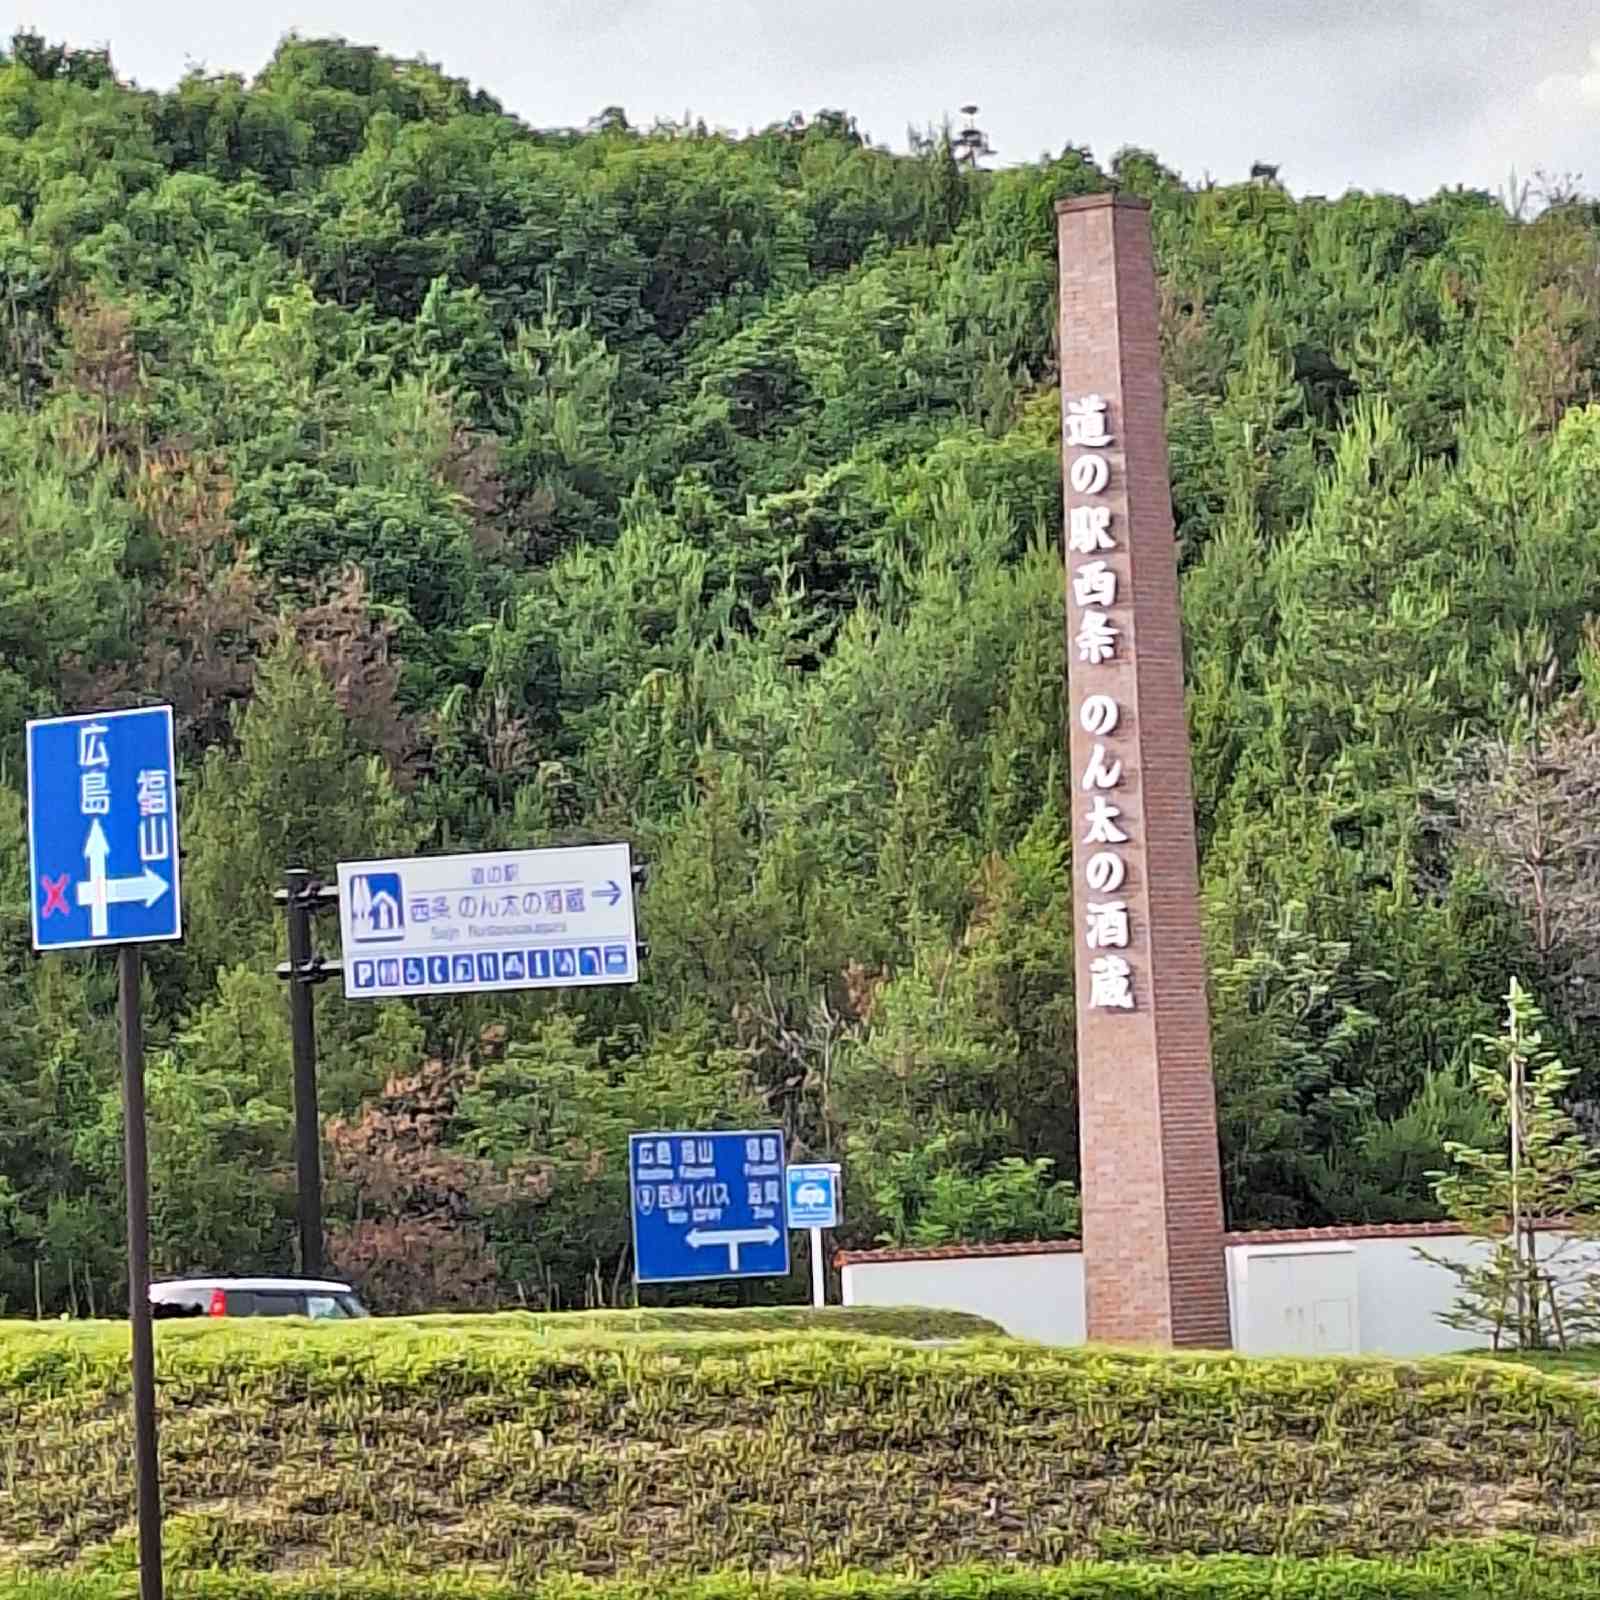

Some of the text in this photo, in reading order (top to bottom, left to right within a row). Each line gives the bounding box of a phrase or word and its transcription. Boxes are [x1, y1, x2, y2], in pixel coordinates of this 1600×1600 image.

[1065, 394, 1135, 1009] 道の駅西条 のん太の酒蔵
[78, 723, 111, 815] 広島
[136, 769, 169, 861] 福山
